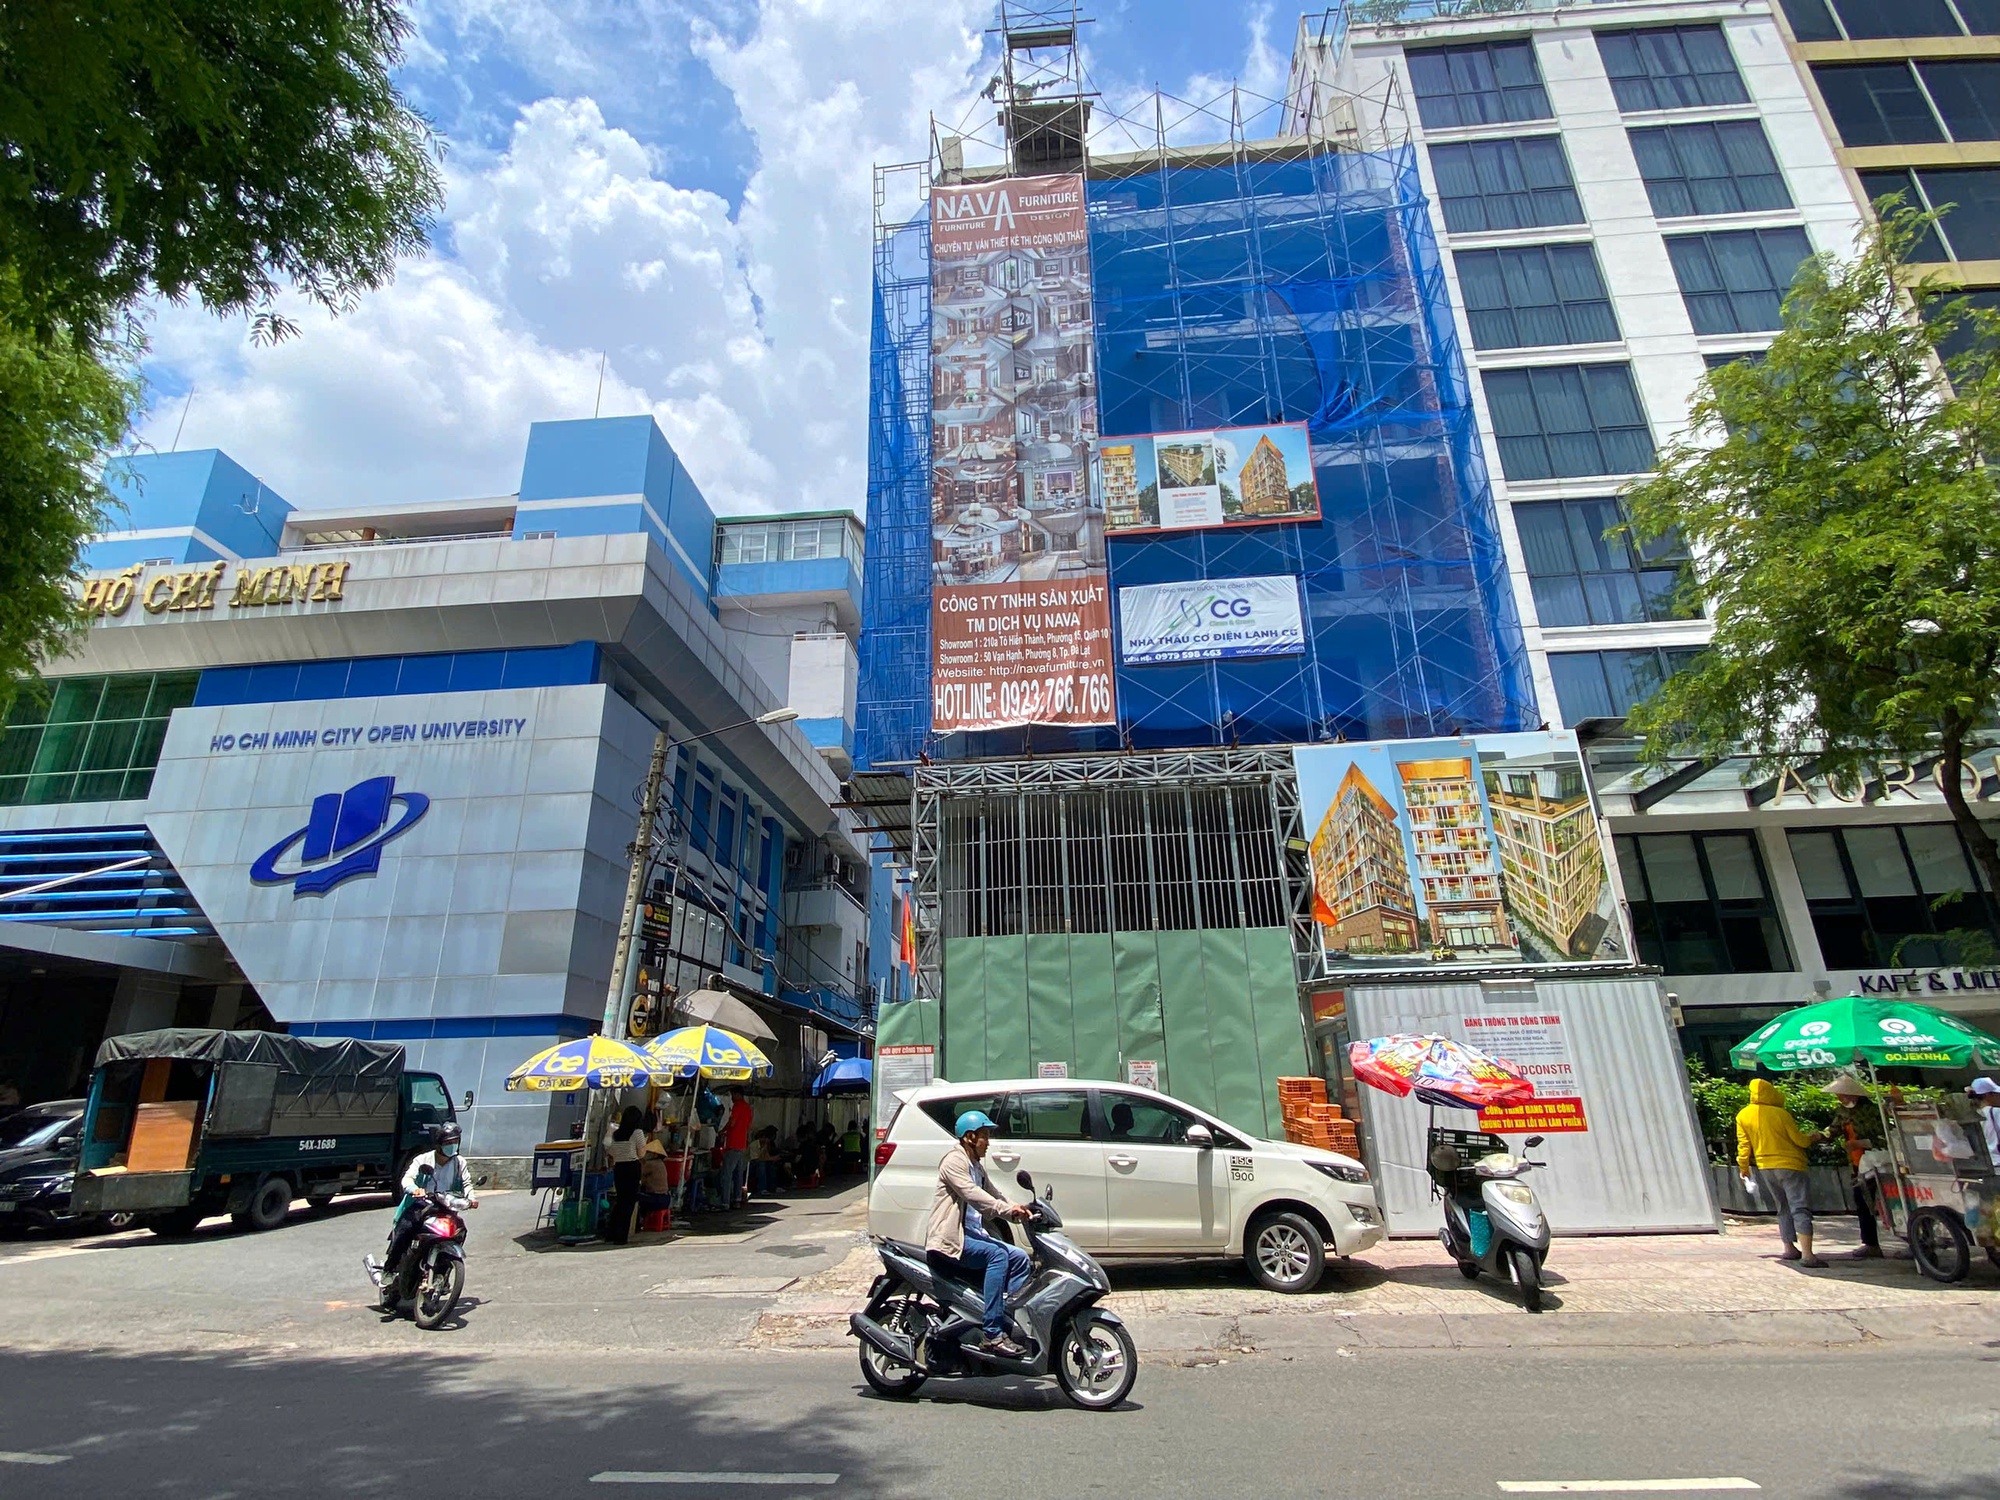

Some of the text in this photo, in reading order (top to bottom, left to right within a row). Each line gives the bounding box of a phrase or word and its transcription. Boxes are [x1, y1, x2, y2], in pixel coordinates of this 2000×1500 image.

[936, 189, 1079, 231] NAVA FURNITURE
[939, 211, 1071, 232] FURNITURE DESIGN
[934, 229, 1085, 254] CHUYÊN TƯ VẤN THIẾT KẾ THI CÔNG NỘI THẤT
[79, 560, 350, 617] HỒ CHÍ MINH
[939, 584, 1104, 613] CÔNG TY TNHH SẢN XUẤT
[1210, 597, 1251, 619] CG
[966, 612, 1080, 634] TM DỊCH VỤ NAVA
[939, 639, 973, 650] Showroom
[974, 637, 978, 648] 1
[983, 636, 998, 648] 210a
[1024, 634, 1045, 645] Thành,
[1047, 632, 1073, 644] Phường
[1084, 628, 1100, 641] Quận
[1101, 628, 1108, 639] 10
[1129, 636, 1153, 648] NHÀ
[1157, 633, 1190, 645] THẦU
[1193, 631, 1210, 642] CƠ
[1213, 630, 1242, 643] ĐIỆN
[1245, 629, 1279, 641] LẠNH
[939, 654, 973, 665] Showroom
[974, 652, 979, 663] 2
[983, 651, 992, 663] 50
[992, 651, 1005, 664] Vạn
[1005, 649, 1024, 663] Hạnh,
[1025, 648, 1051, 660] Phường
[1052, 647, 1058, 659] 8,
[1059, 646, 1070, 659] Tp.
[1070, 644, 1079, 655] Đà
[1080, 645, 1090, 657] Lạt
[1154, 652, 1180, 661] 0979
[1181, 650, 1201, 658] 598
[1202, 649, 1221, 657] 463
[937, 658, 1104, 678] Websiite: http://navafurniture.vn
[934, 673, 1110, 721] HOTLINE: 0923.766.766
[210, 718, 527, 752] HO CHI MINH CITY OPEN UNIVERSITY
[1774, 755, 2000, 806] AURO
[1858, 968, 1921, 993] KAFÉ
[1927, 972, 1948, 991] &
[1483, 1016, 1506, 1027] THÔNG
[1507, 1016, 1519, 1026] TIN
[1520, 1015, 1539, 1025] CÔNG
[1540, 1015, 1561, 1025] TRÌNH
[1783, 1036, 1831, 1050] gojek
[1881, 1034, 1939, 1046] gojek
[545, 1052, 584, 1073] be
[592, 1055, 635, 1064] be Food
[705, 1042, 741, 1064] be
[1885, 1053, 1951, 1061] GOJEKNHA
[538, 1078, 573, 1090] ĐẶT XE
[600, 1072, 635, 1088] 50K
[1544, 1103, 1556, 1113] THI
[1557, 1102, 1576, 1113] CÔNG
[1230, 1155, 1253, 1165] HSC
[1231, 1171, 1255, 1182] 1900
